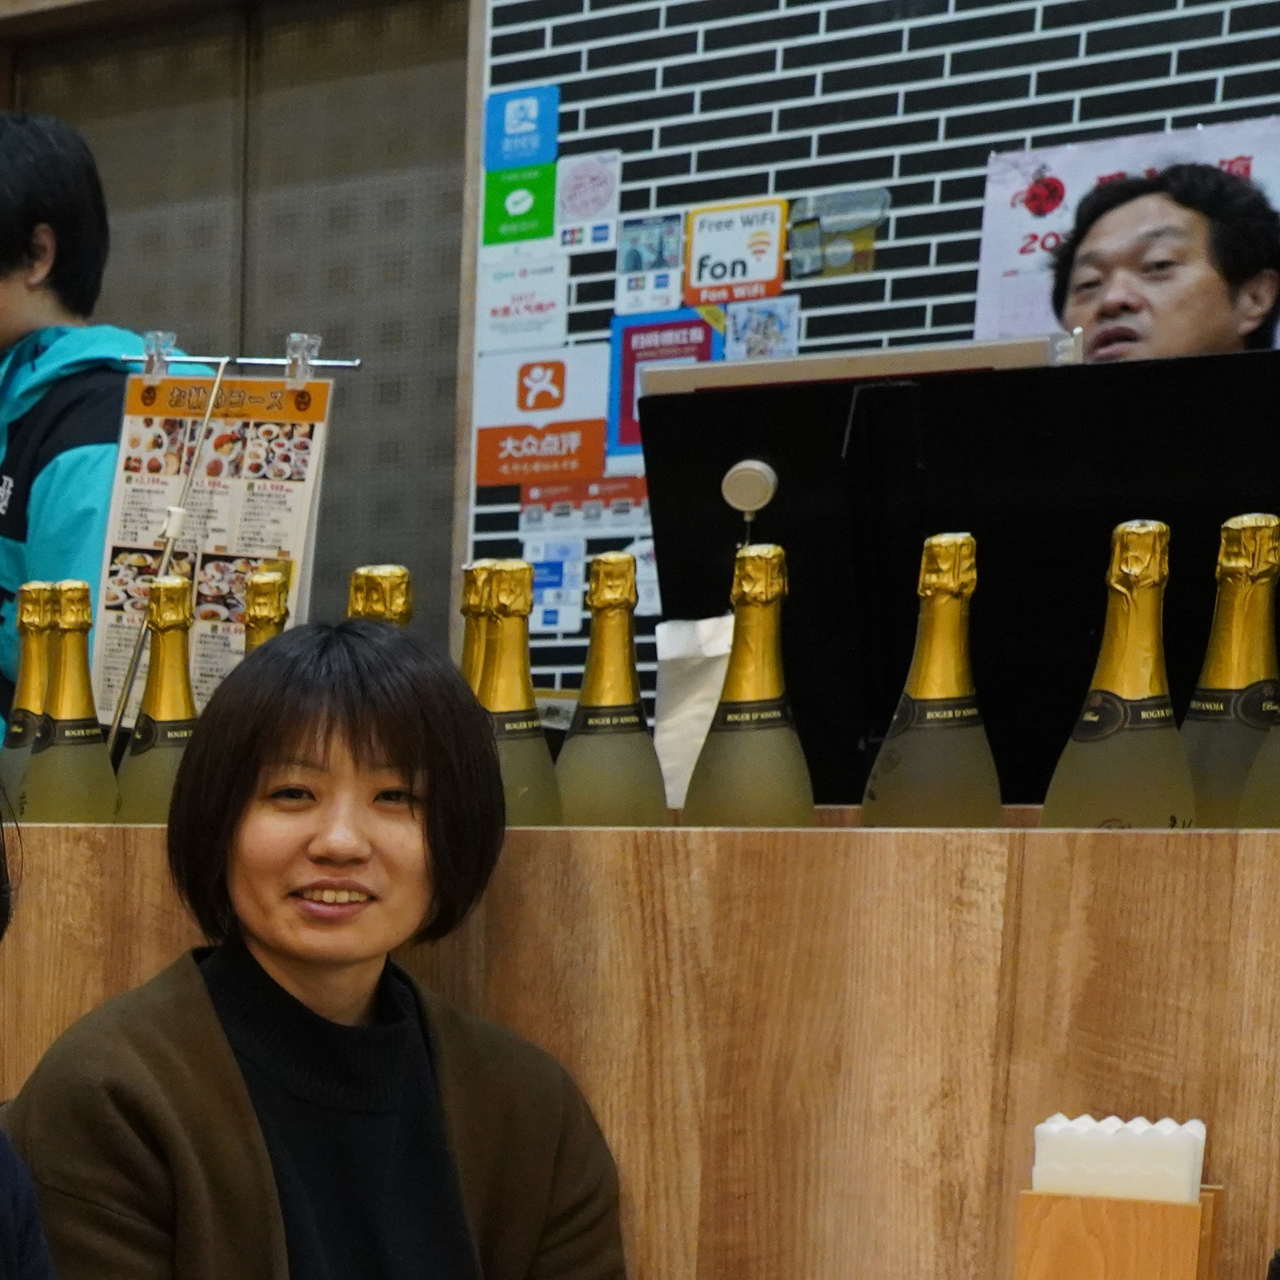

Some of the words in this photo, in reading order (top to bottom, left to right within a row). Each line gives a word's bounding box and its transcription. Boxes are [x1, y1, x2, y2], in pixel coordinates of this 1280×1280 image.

[699, 219, 733, 231] Free
[740, 212, 775, 227] WiFi
[1019, 231, 1061, 254] 20
[698, 254, 747, 281] fon
[498, 429, 581, 458] 大众点评
[727, 712, 751, 722] ROGER
[927, 709, 953, 719] ROGER
